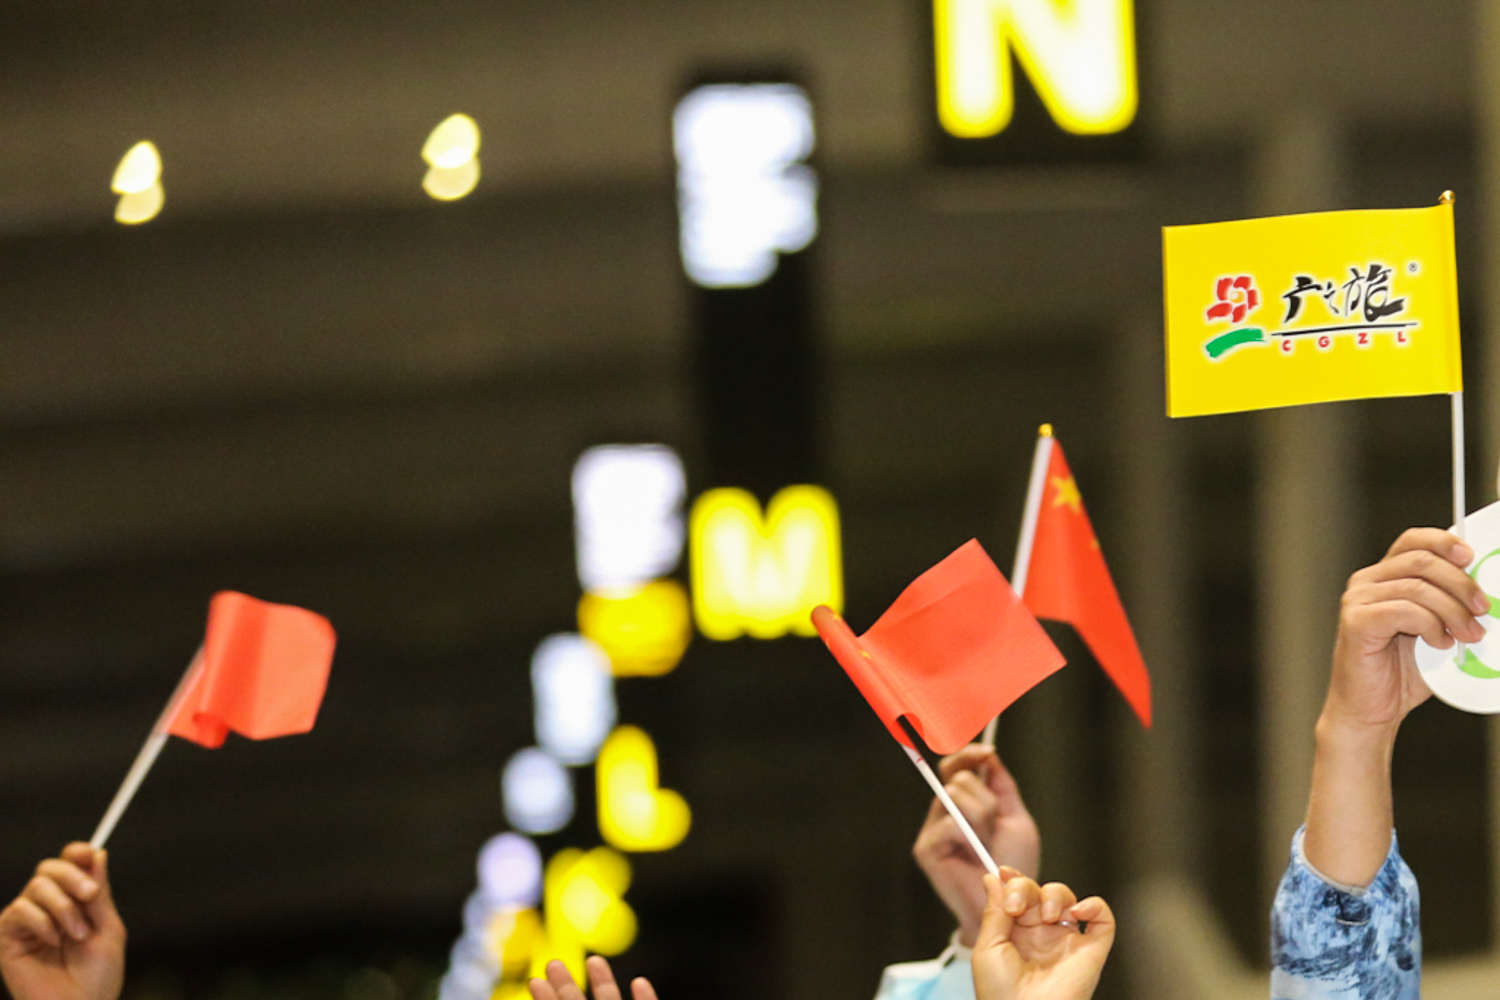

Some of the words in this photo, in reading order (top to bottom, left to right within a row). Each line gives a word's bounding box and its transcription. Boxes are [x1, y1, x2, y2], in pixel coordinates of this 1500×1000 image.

[934, 0, 1138, 137] N
[1283, 264, 1405, 323] 广之旅
